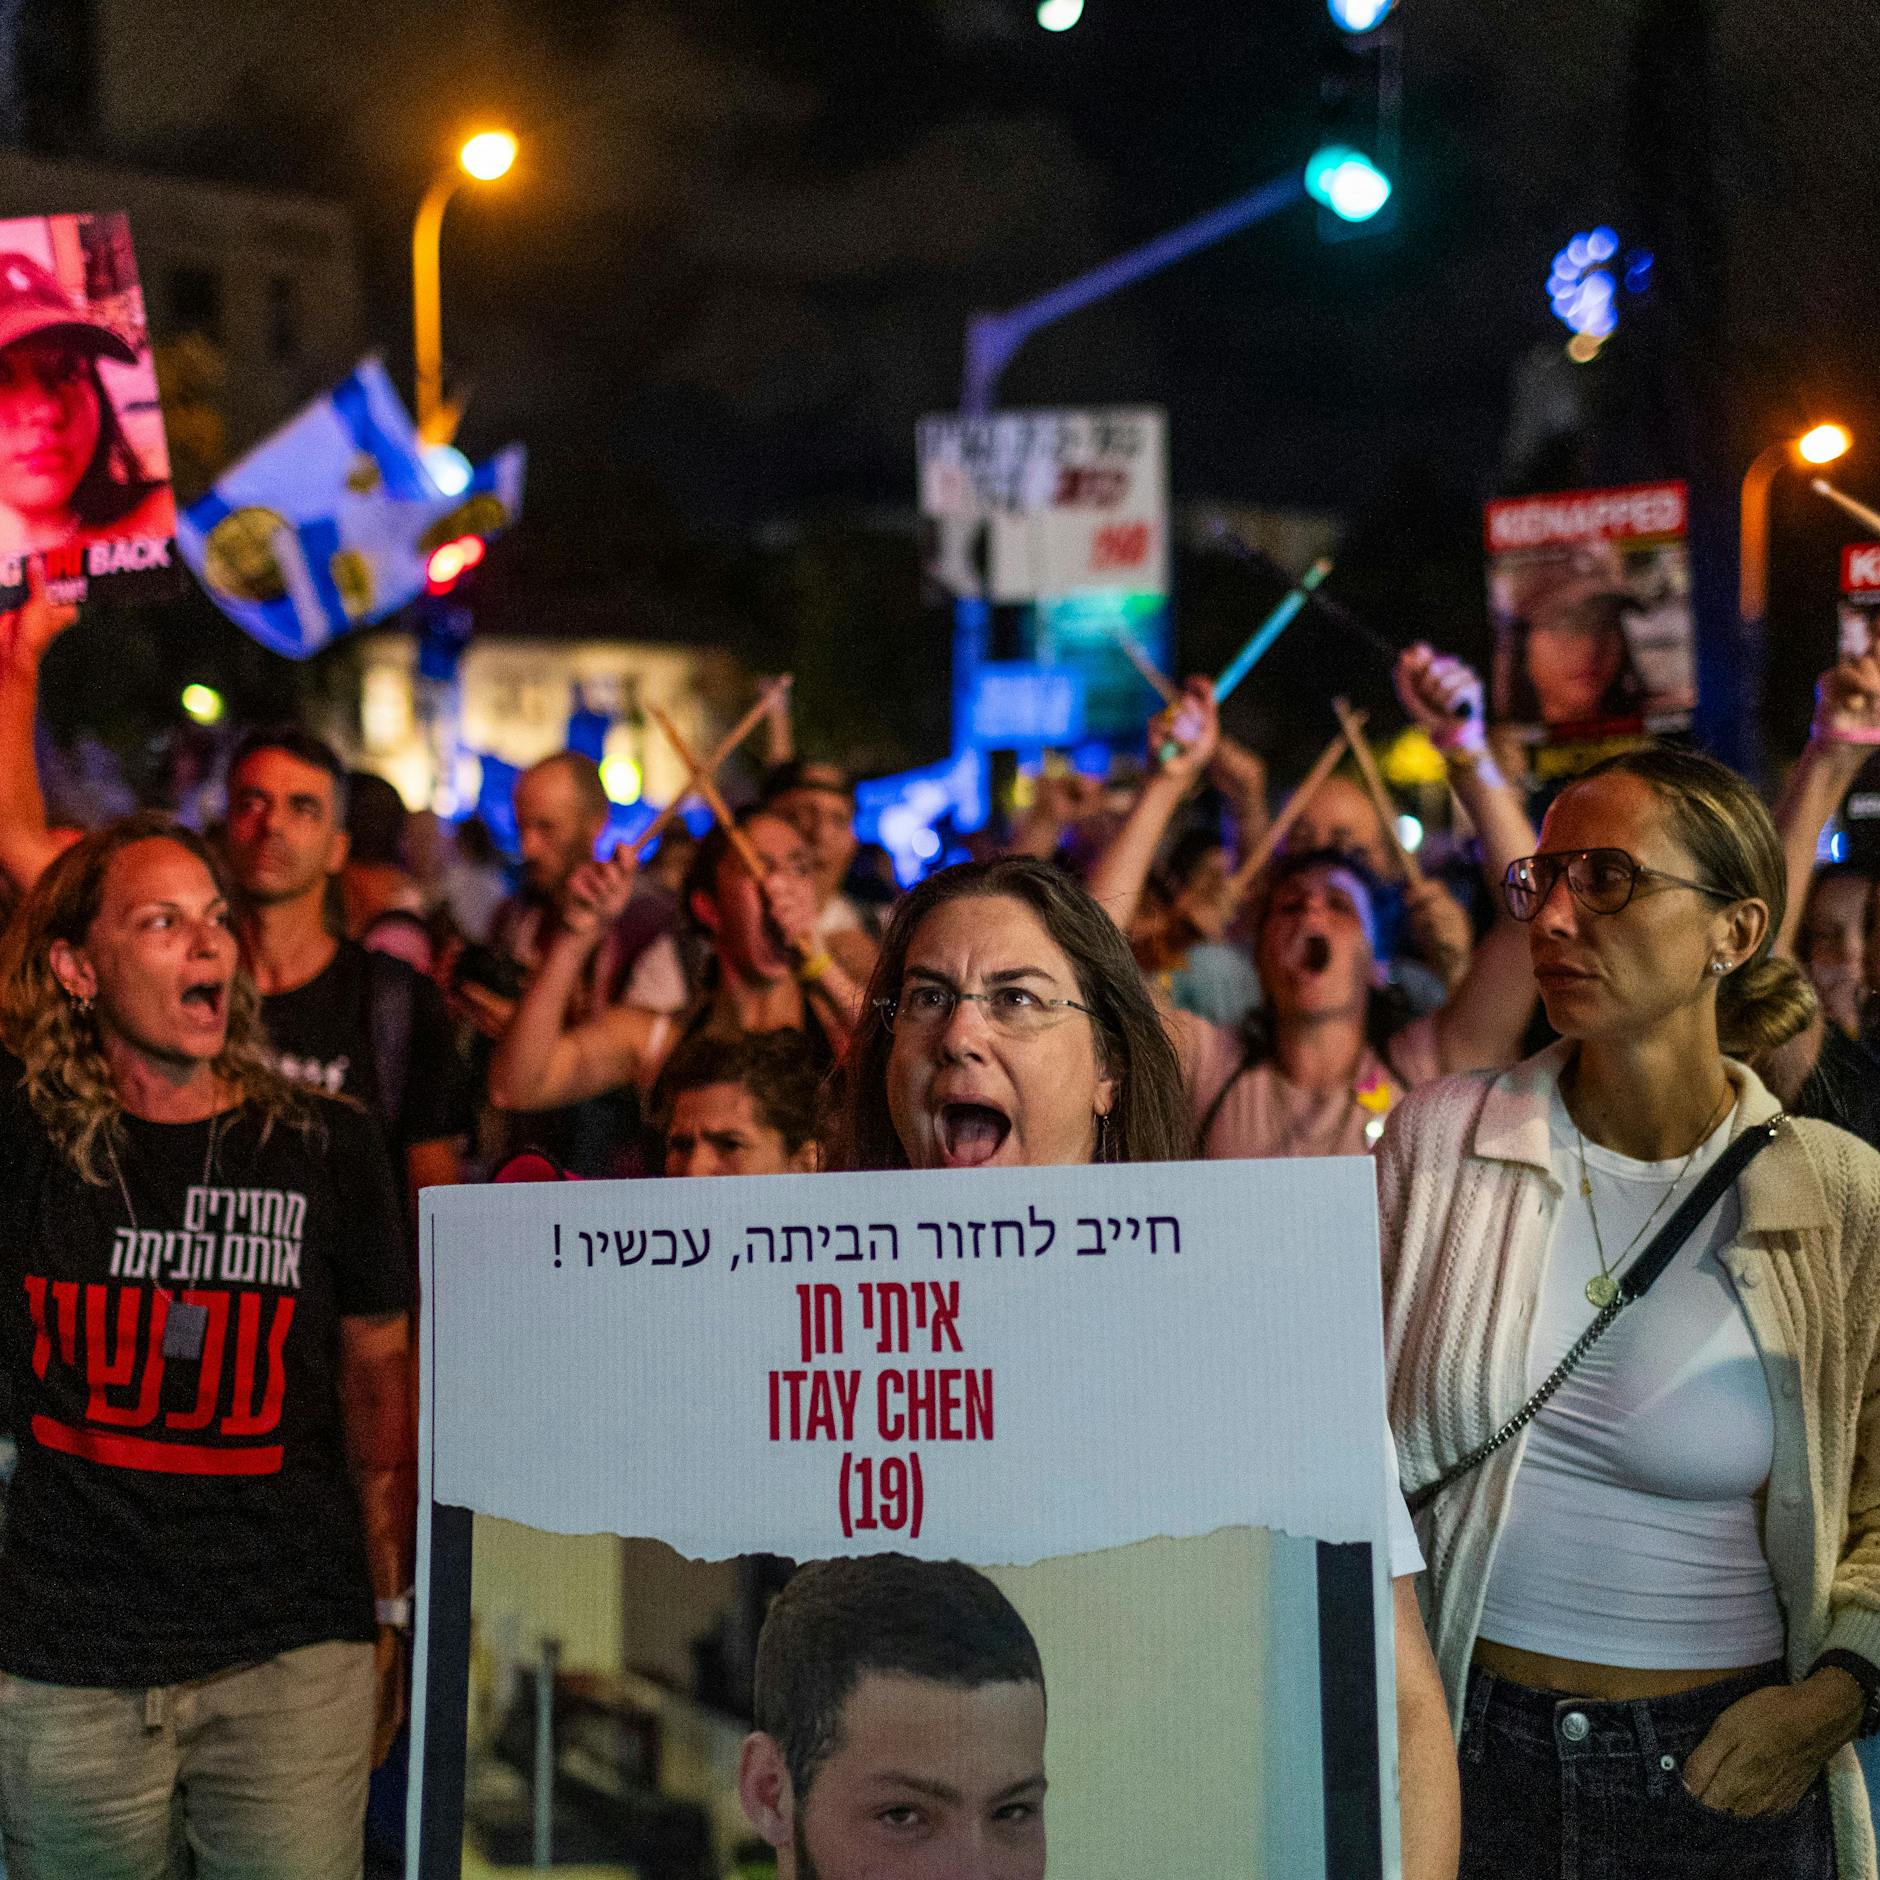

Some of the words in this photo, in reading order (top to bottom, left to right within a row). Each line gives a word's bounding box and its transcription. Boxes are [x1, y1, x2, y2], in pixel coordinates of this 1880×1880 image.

[90, 538, 170, 576] BACK
[185, 1187, 307, 1240] מחזירים
[916, 1206, 1056, 1260] לחזור
[1076, 1215, 1183, 1256] חייב
[110, 1227, 216, 1280] הביתה
[220, 1233, 302, 1288] אותם
[578, 1225, 711, 1267] עכשיו
[730, 1222, 899, 1271] הביתה,
[796, 1283, 844, 1362] חן
[858, 1281, 964, 1353] איתי
[24, 1275, 296, 1436] עכשיו
[768, 1370, 862, 1440] ITAY
[877, 1368, 994, 1441] CHEN
[839, 1452, 925, 1538] (19)
